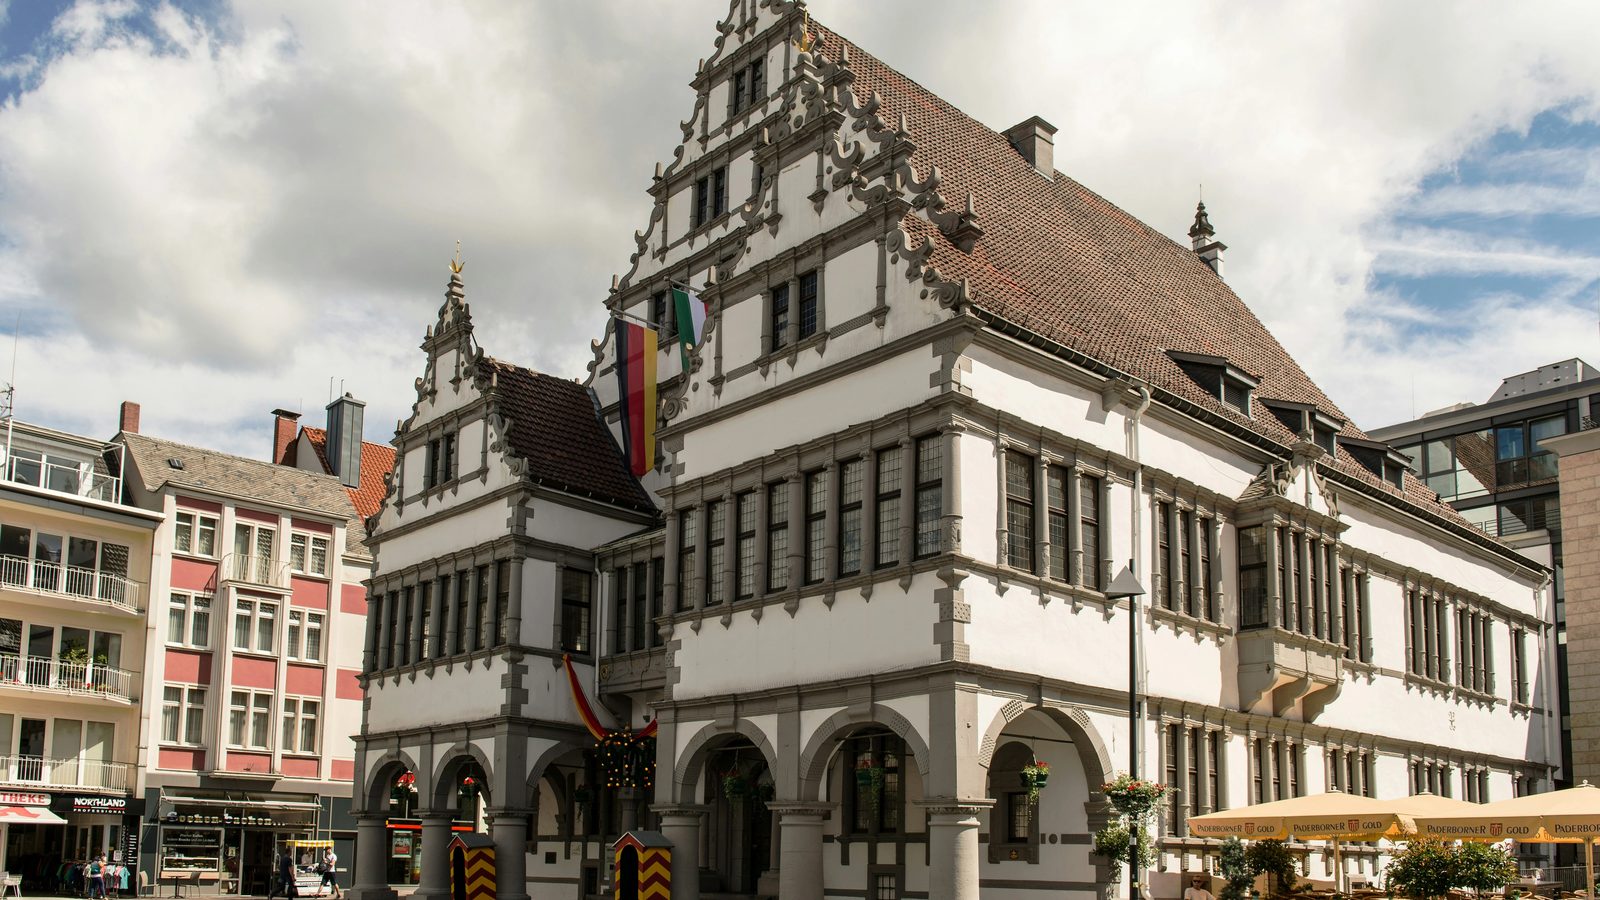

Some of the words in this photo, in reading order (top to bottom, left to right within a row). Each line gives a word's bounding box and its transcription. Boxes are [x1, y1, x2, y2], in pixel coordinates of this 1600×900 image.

[0, 792, 46, 803] THEKE
[74, 797, 126, 807] NORTHLAND
[1197, 824, 1242, 833] PADERBORNER
[1257, 825, 1275, 833] GOLD
[1293, 822, 1345, 832] PADERBORNER
[1362, 821, 1382, 830] GOLD
[1427, 824, 1486, 834] PADERBORNER
[1506, 826, 1529, 834] GOLD
